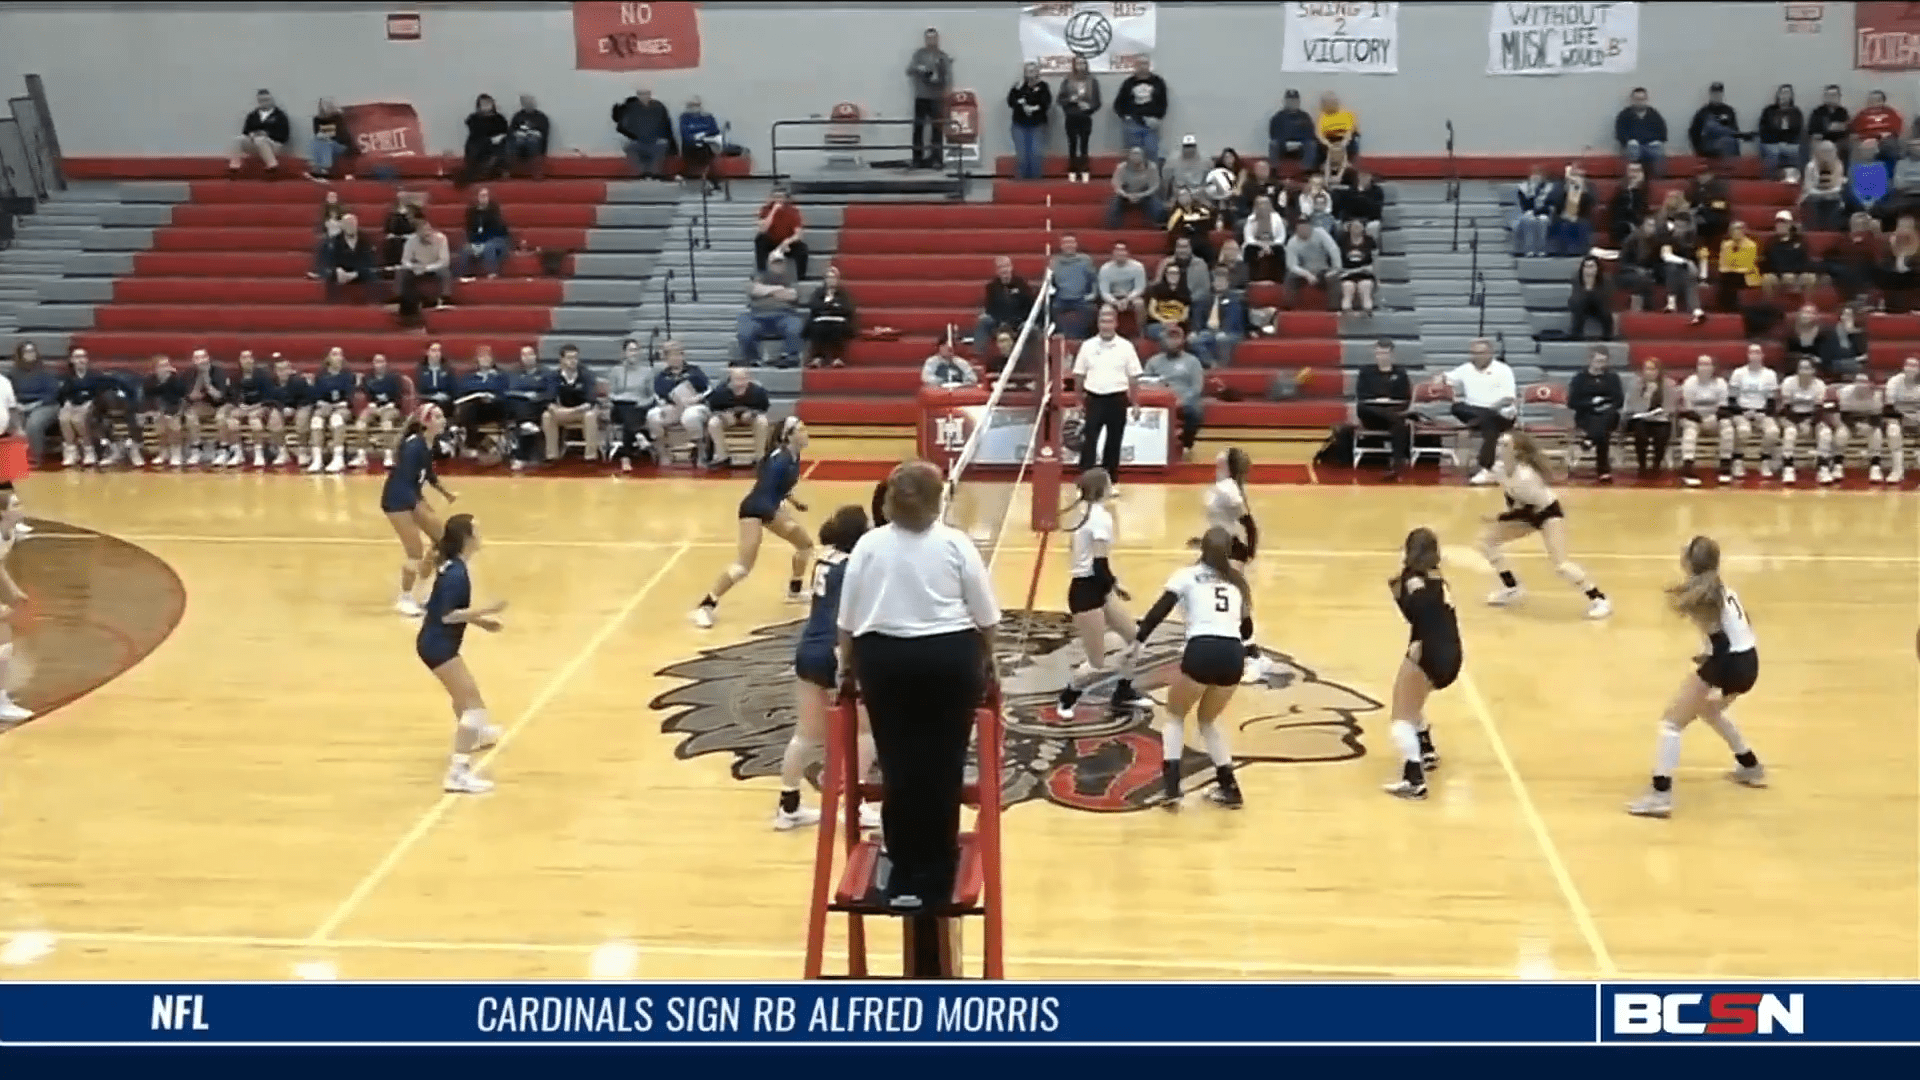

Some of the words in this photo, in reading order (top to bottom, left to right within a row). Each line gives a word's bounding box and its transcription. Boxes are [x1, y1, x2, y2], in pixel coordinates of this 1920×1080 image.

[621, 3, 652, 24] NO
[1507, 3, 1615, 25] WITHOUT
[1334, 18, 1347, 36] 2
[1562, 26, 1598, 46] LIFE
[1303, 37, 1391, 64] VICTORY
[1214, 586, 1229, 613] 5
